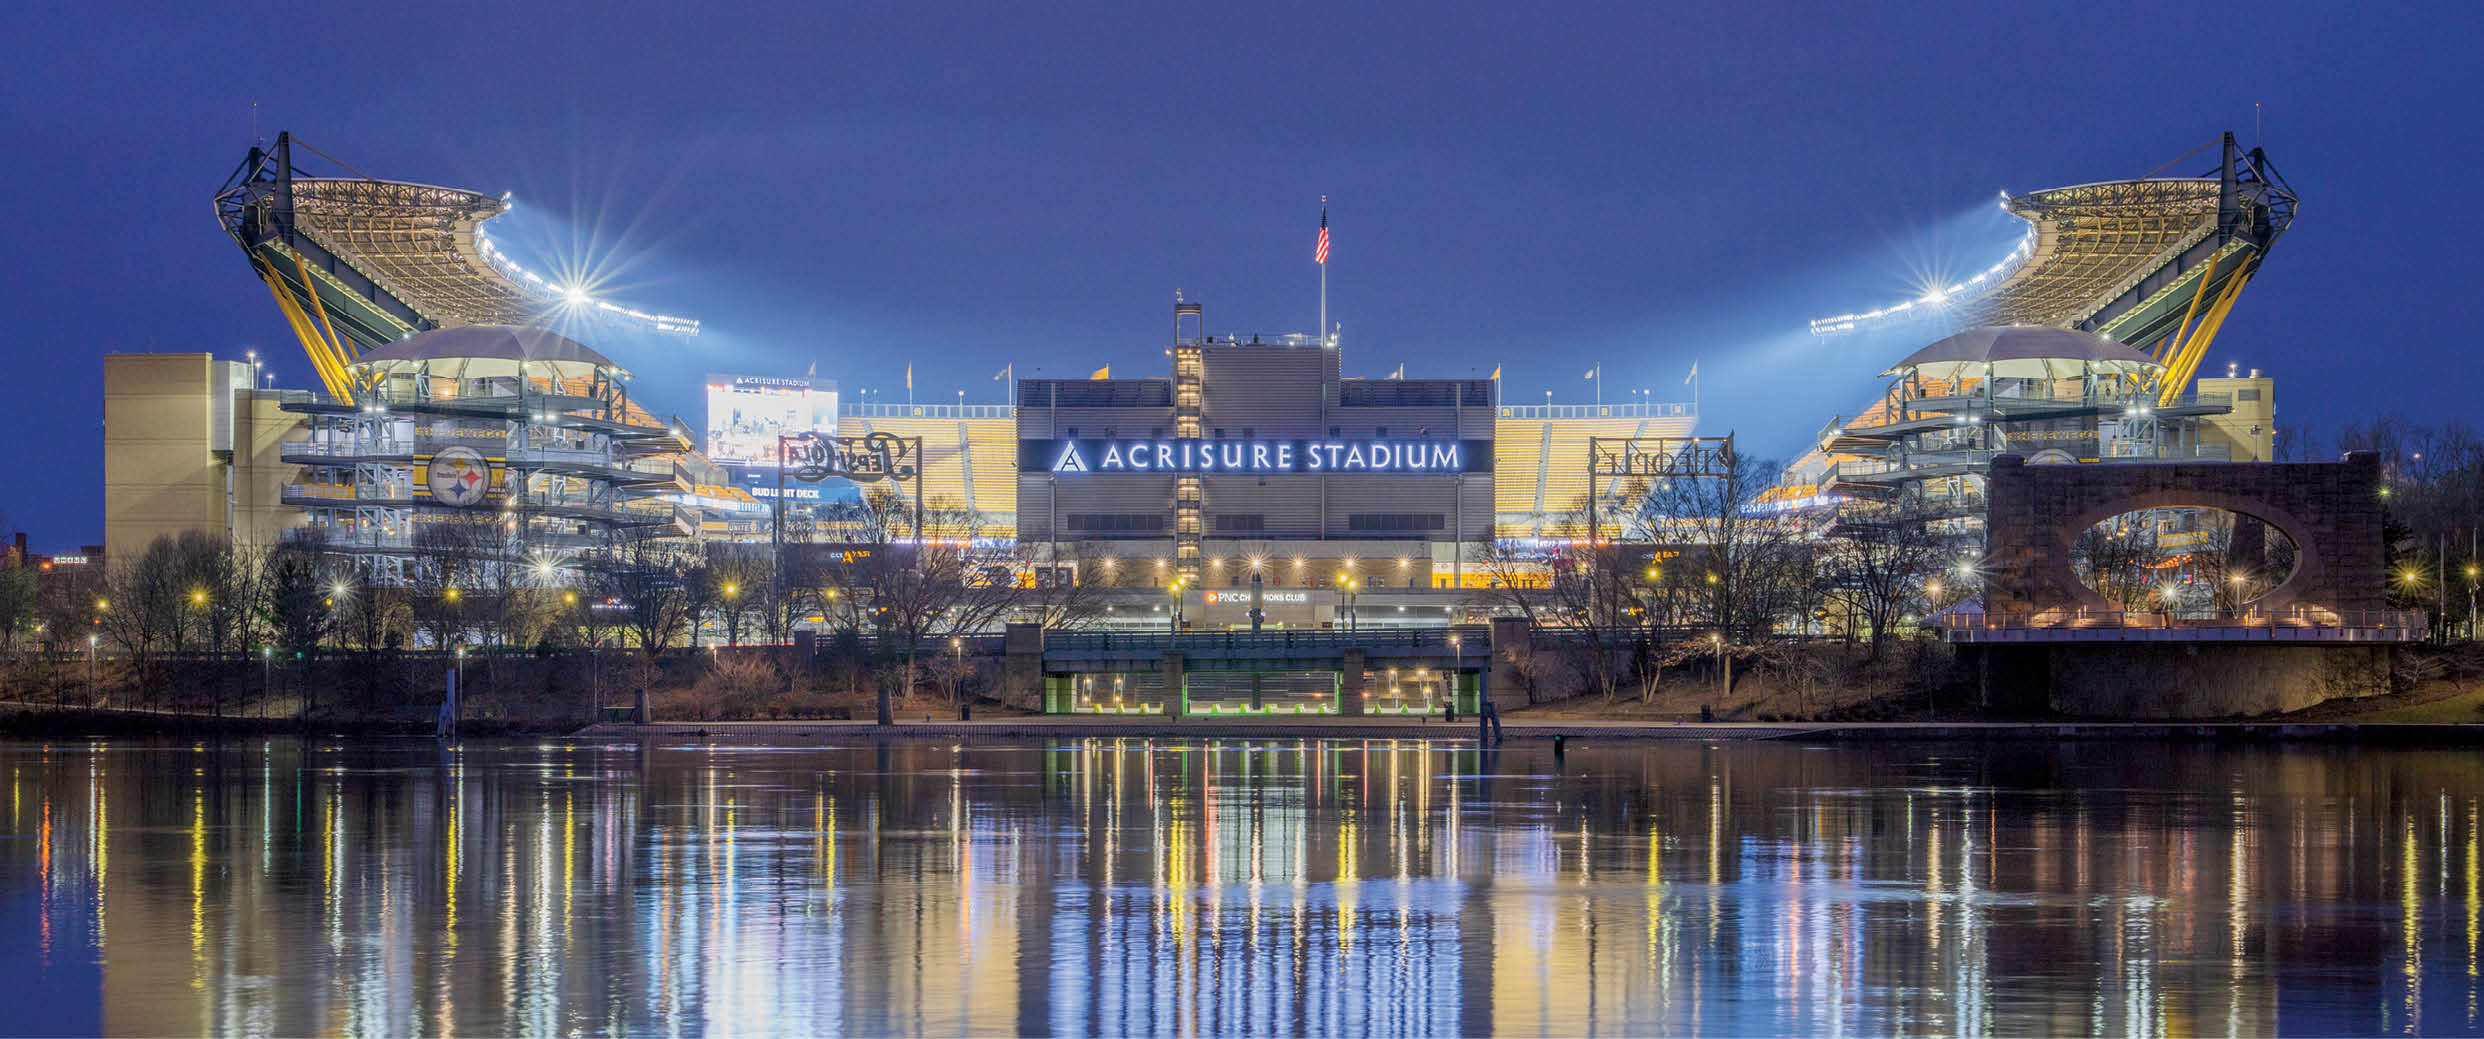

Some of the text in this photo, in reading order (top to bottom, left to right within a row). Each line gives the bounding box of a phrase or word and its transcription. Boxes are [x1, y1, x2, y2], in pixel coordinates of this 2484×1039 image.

[744, 377, 811, 388] ACRISURE STADIUM
[1102, 443, 1460, 469] ACRISURE STADIUM
[751, 487, 820, 499] BUD LIHT DECK
[1218, 593, 1306, 602] PNC CHPIONS CLUB
